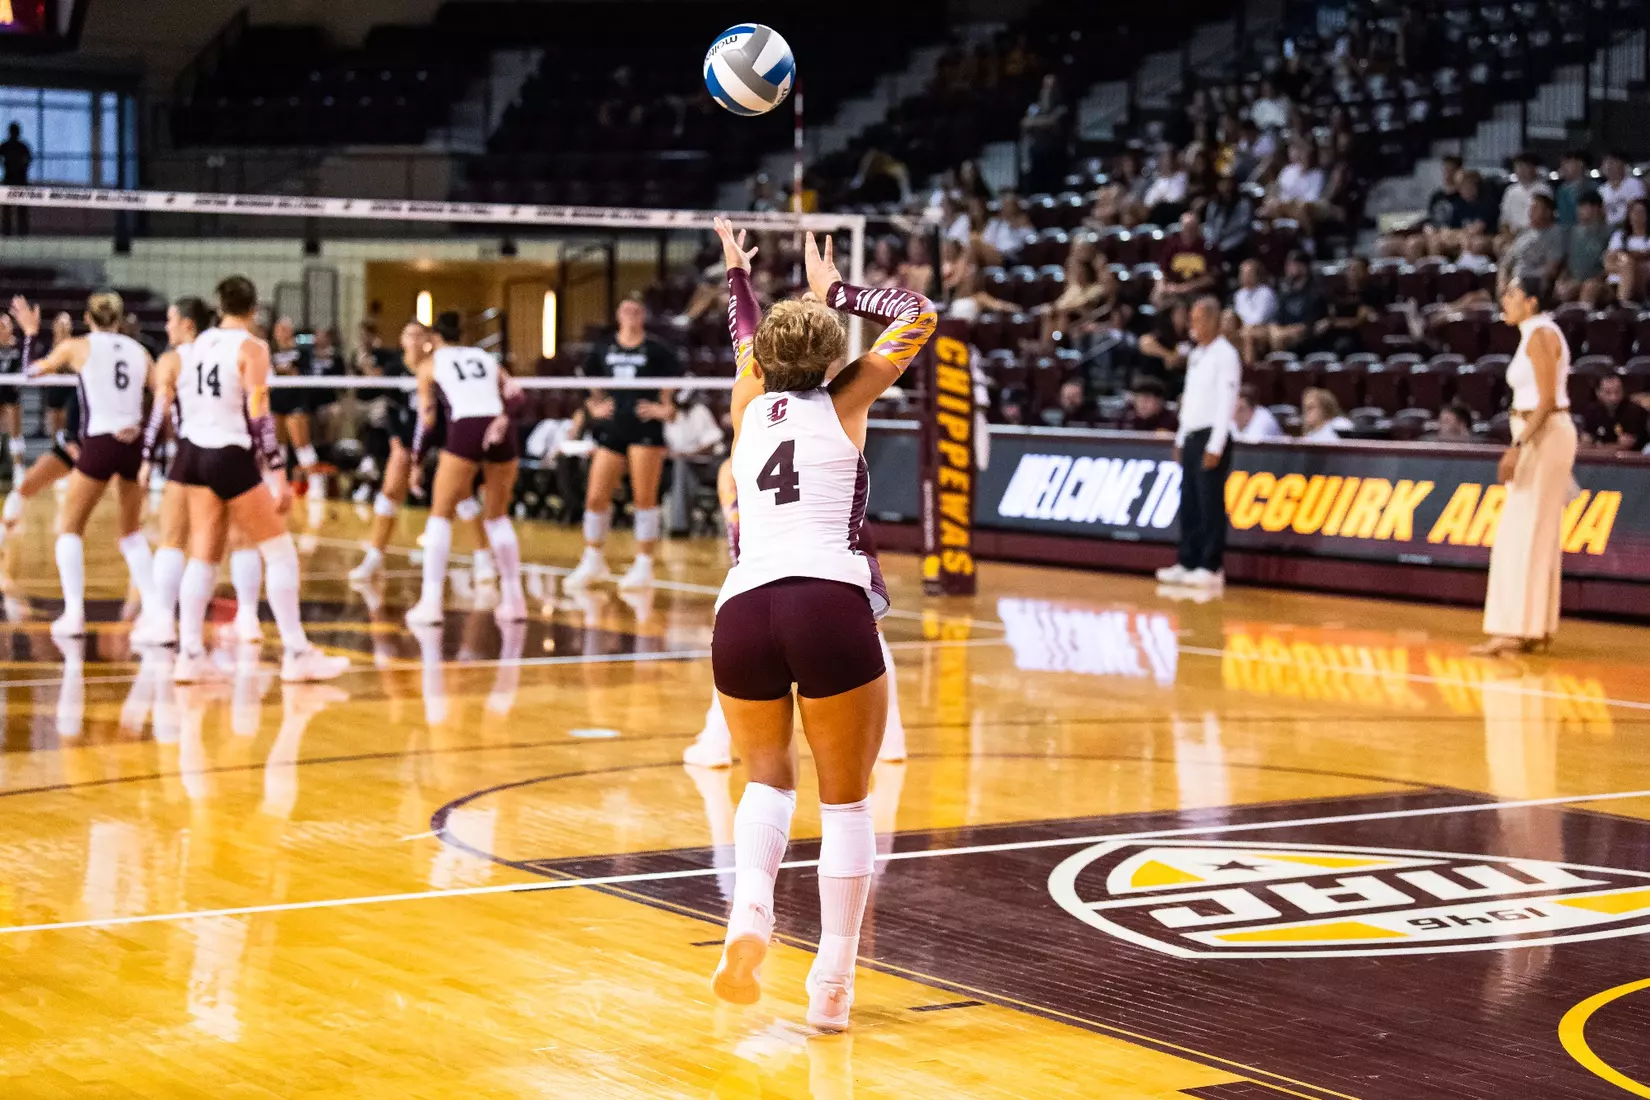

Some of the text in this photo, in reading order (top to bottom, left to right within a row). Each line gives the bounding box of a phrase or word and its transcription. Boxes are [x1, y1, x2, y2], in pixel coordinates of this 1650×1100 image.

[114, 360, 130, 390] 6
[197, 362, 222, 397] 14
[451, 358, 487, 381] 13
[756, 439, 800, 506] 4
[935, 335, 974, 575] CHIPPEWAS
[998, 453, 1156, 525] WELCOME
[1427, 483, 1622, 555] ARA
[1148, 861, 1611, 929] MAC
[1406, 906, 1550, 931] 1946
